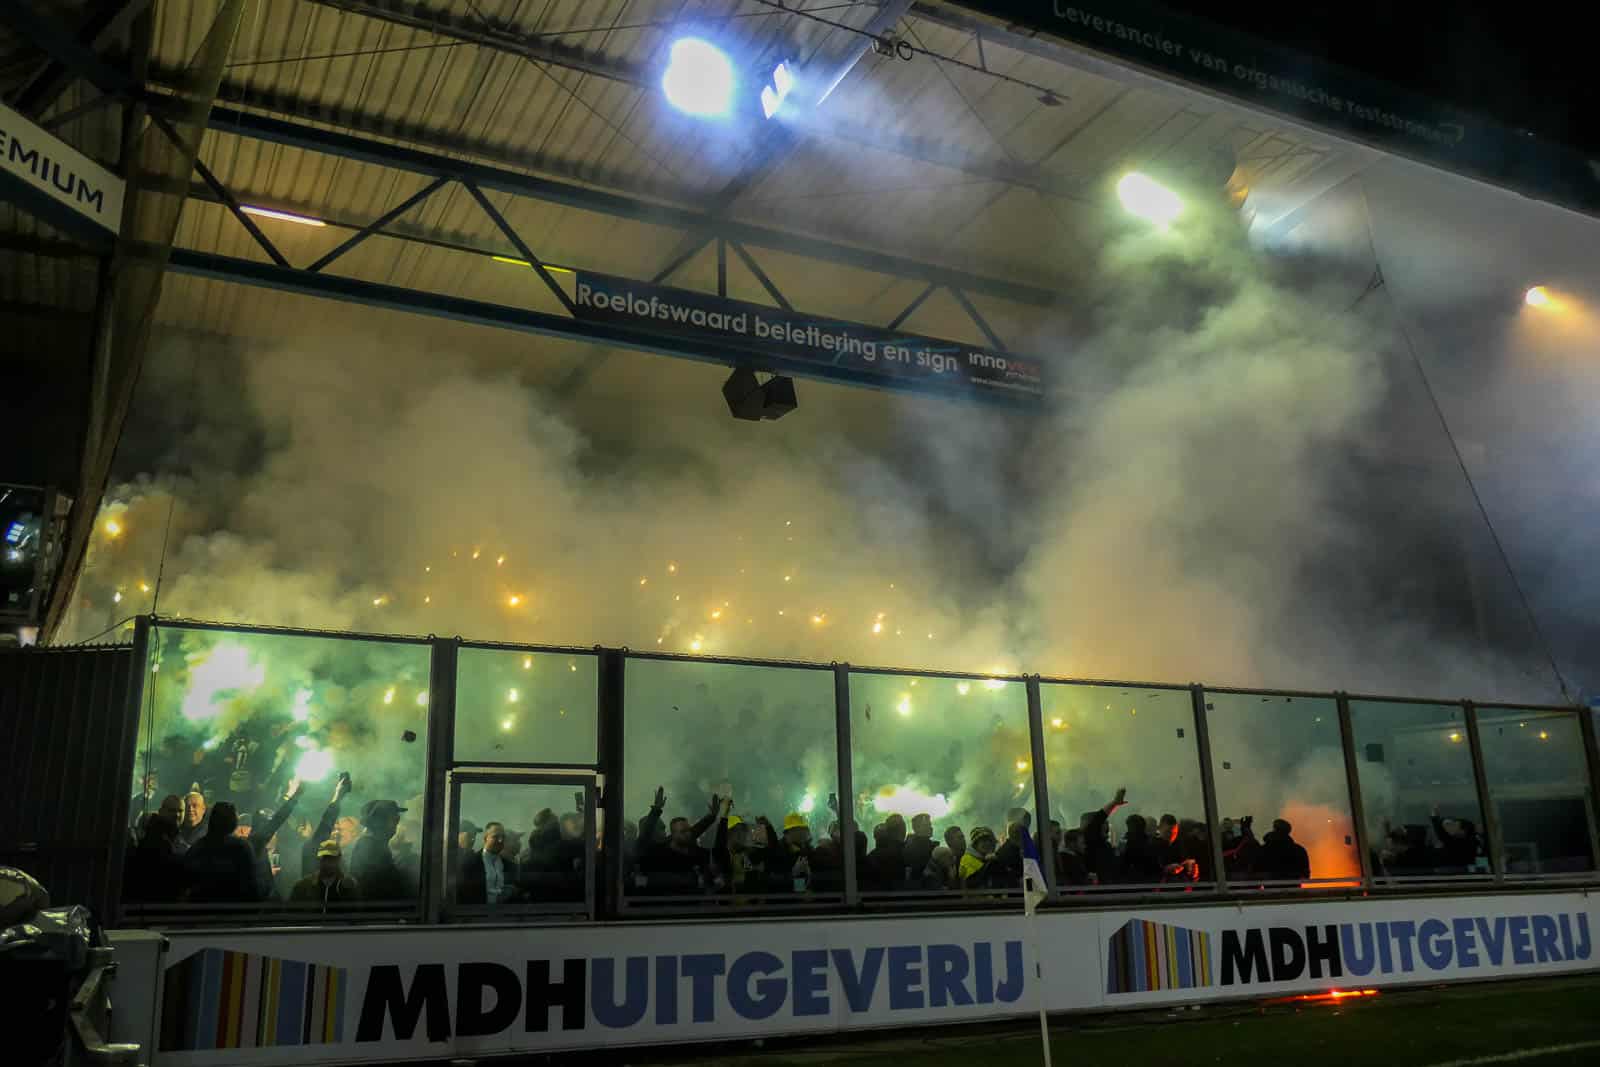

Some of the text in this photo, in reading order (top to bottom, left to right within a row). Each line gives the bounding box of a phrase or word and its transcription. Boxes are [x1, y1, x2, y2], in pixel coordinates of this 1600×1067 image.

[1052, 0, 1184, 57] Leverancier
[1188, 48, 1228, 73] van
[577, 283, 959, 373] Roelofswaard belettering en sign
